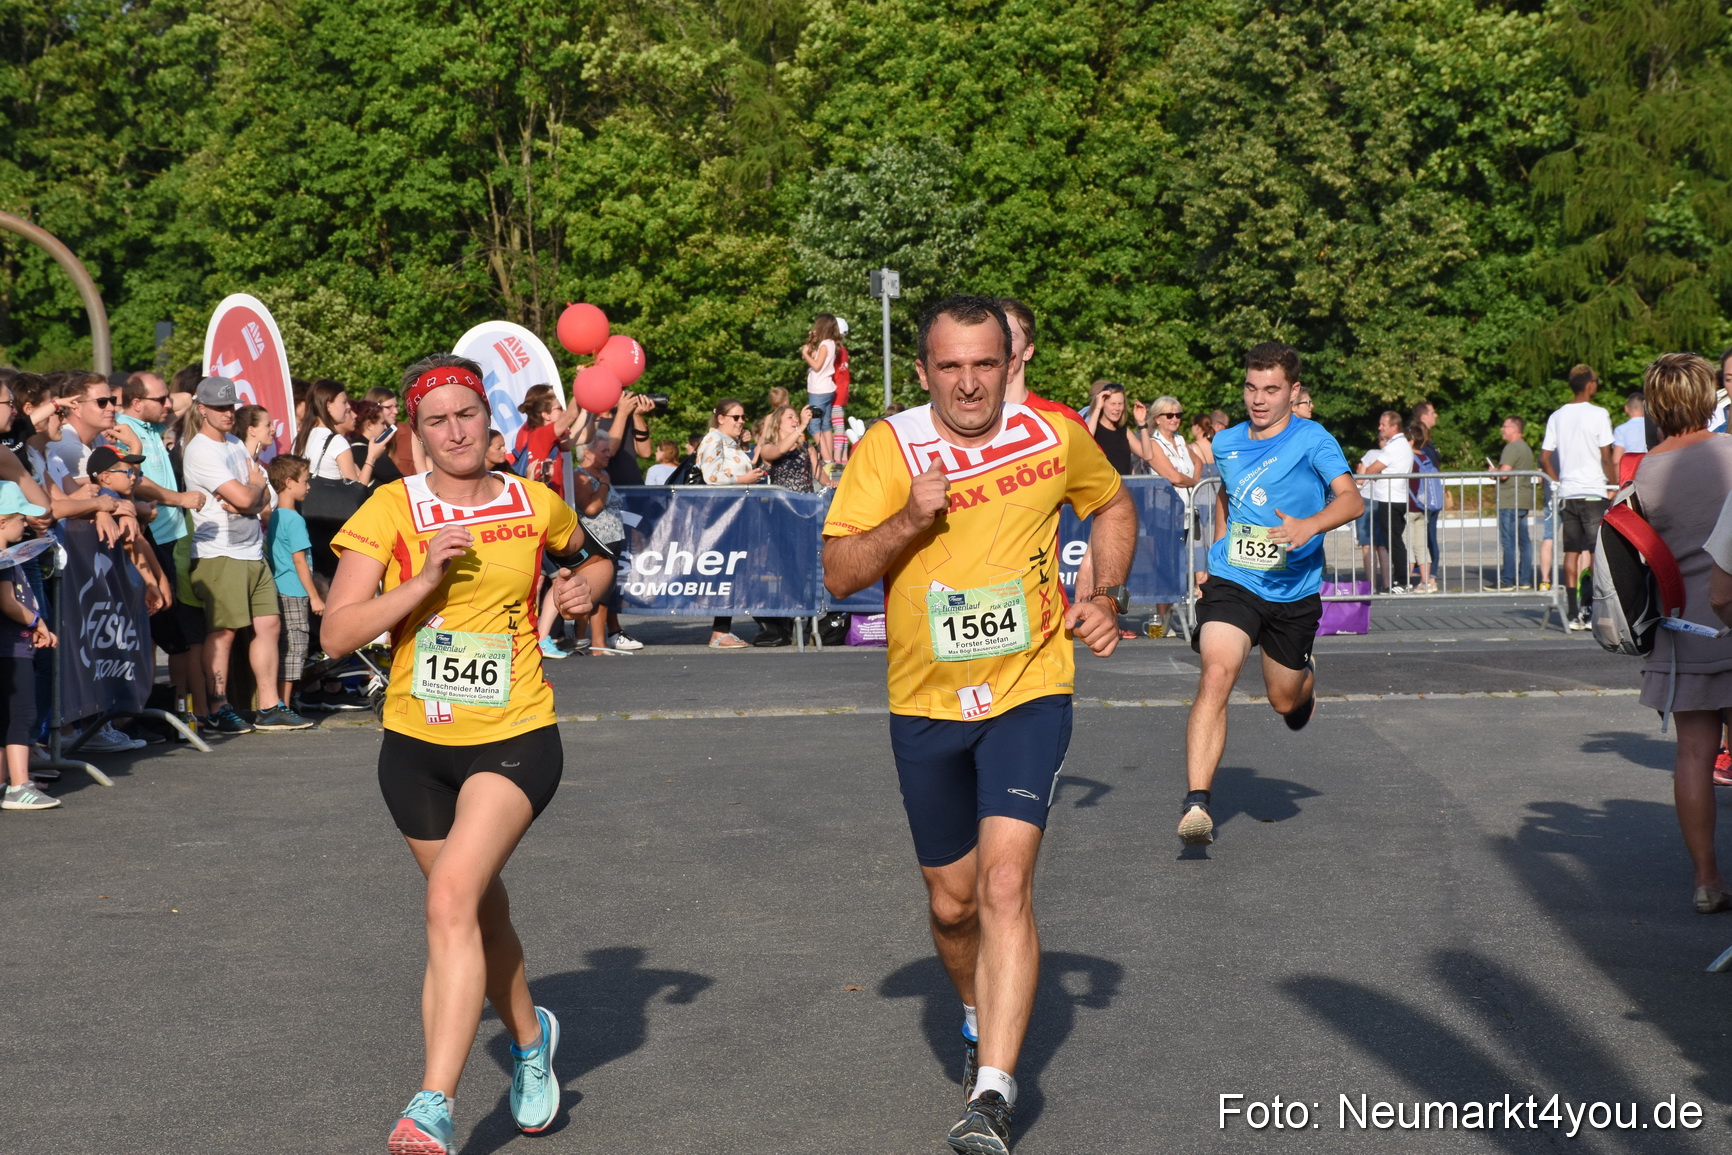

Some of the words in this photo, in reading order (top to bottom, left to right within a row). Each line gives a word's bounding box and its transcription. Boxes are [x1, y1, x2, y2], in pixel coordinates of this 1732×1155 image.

[1239, 466, 1262, 486] Schick
[1262, 456, 1278, 467] Bau
[944, 485, 990, 514] AX
[996, 457, 1066, 496] BÖGL
[481, 523, 539, 544] BÖGL
[1236, 539, 1279, 559] 1532
[617, 541, 747, 576] scher
[617, 582, 732, 596] TOMOBILE
[942, 601, 980, 612] firmenlauf
[1003, 598, 1020, 608] 2019
[943, 608, 1017, 641] 1564
[428, 641, 467, 653] firmenlauf
[956, 640, 983, 649] Forster
[985, 636, 1009, 645] Stefan
[426, 655, 498, 686] 1546
[422, 679, 472, 693] Bierschneider
[474, 686, 500, 694] Marina
[448, 691, 477, 699] Bauservice
